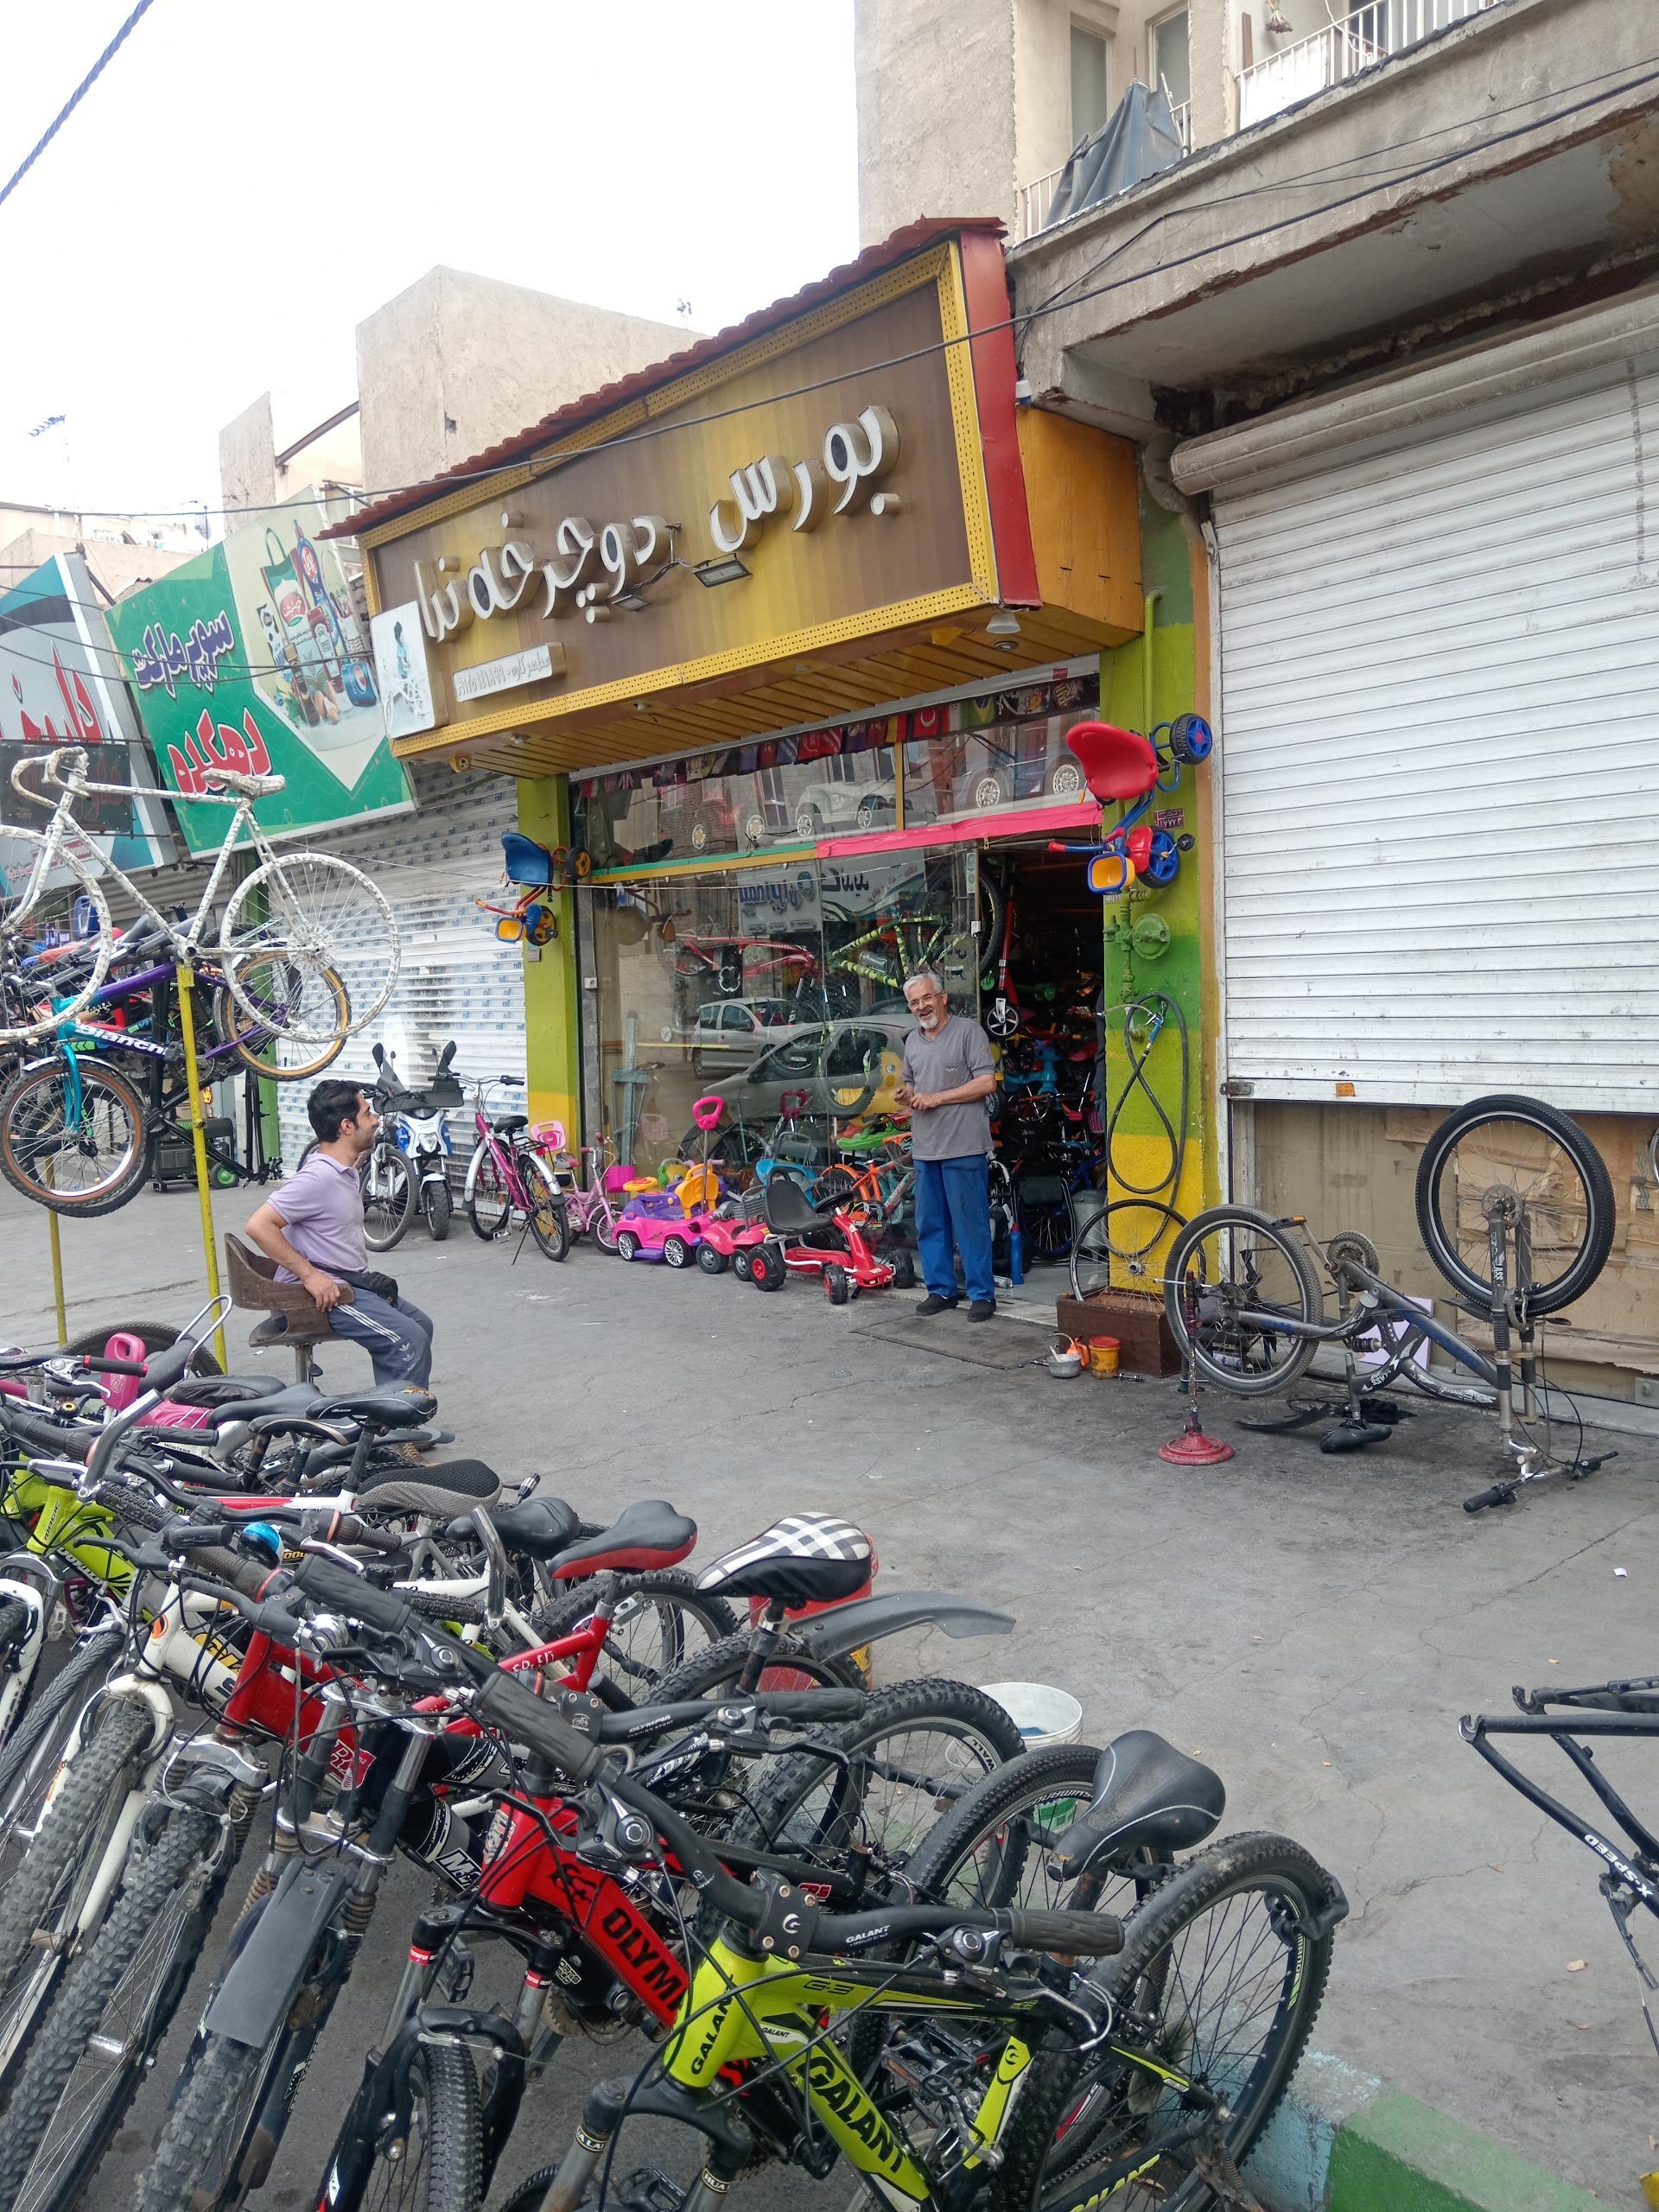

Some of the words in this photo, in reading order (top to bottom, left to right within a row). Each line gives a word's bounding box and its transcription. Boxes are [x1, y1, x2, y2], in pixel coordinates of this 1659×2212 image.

[709, 405, 890, 553] بورس
[467, 513, 660, 624] دوچرخه
[131, 621, 188, 698] مارکت
[185, 608, 235, 693] سوپر
[74, 1019, 169, 1057] Bianchi
[972, 1738, 997, 1771] WALL
[1584, 1834, 1655, 1898] X-SPEED
[845, 1924, 891, 1944] GALANT
[762, 2027, 791, 2038] GALANT
[797, 2056, 904, 2174] GALANT
